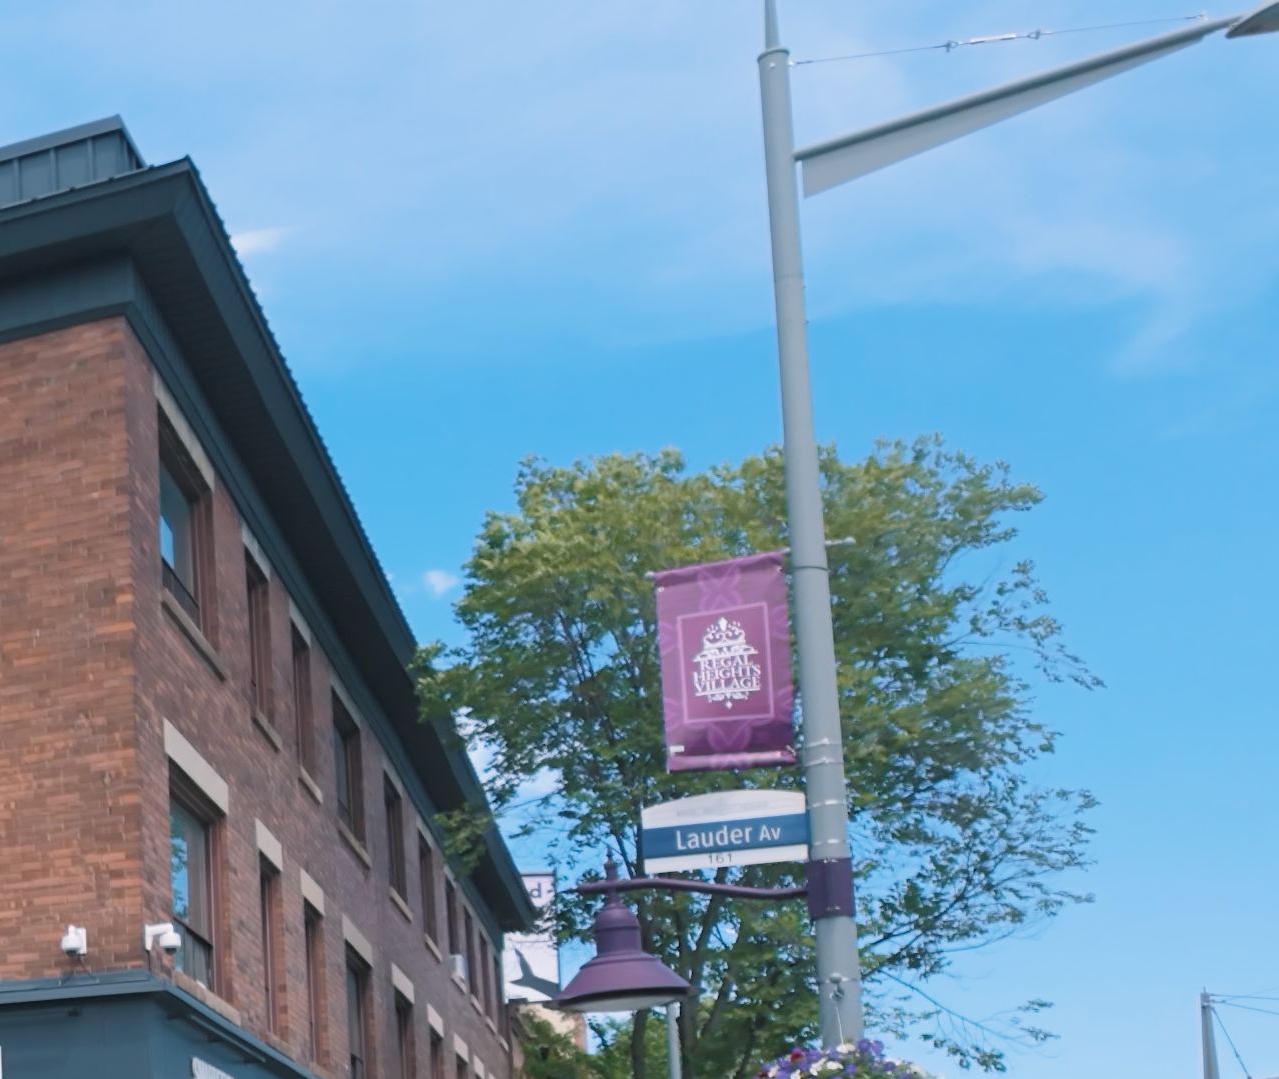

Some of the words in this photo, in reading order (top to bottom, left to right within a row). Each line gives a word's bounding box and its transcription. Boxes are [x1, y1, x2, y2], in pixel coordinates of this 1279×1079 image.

[701, 655, 753, 671] REGAL
[694, 664, 761, 682] HEIGHTS
[694, 676, 761, 692] VILLAGE
[676, 825, 753, 851] Lauder
[759, 824, 781, 842] Av
[708, 853, 733, 864] 161
